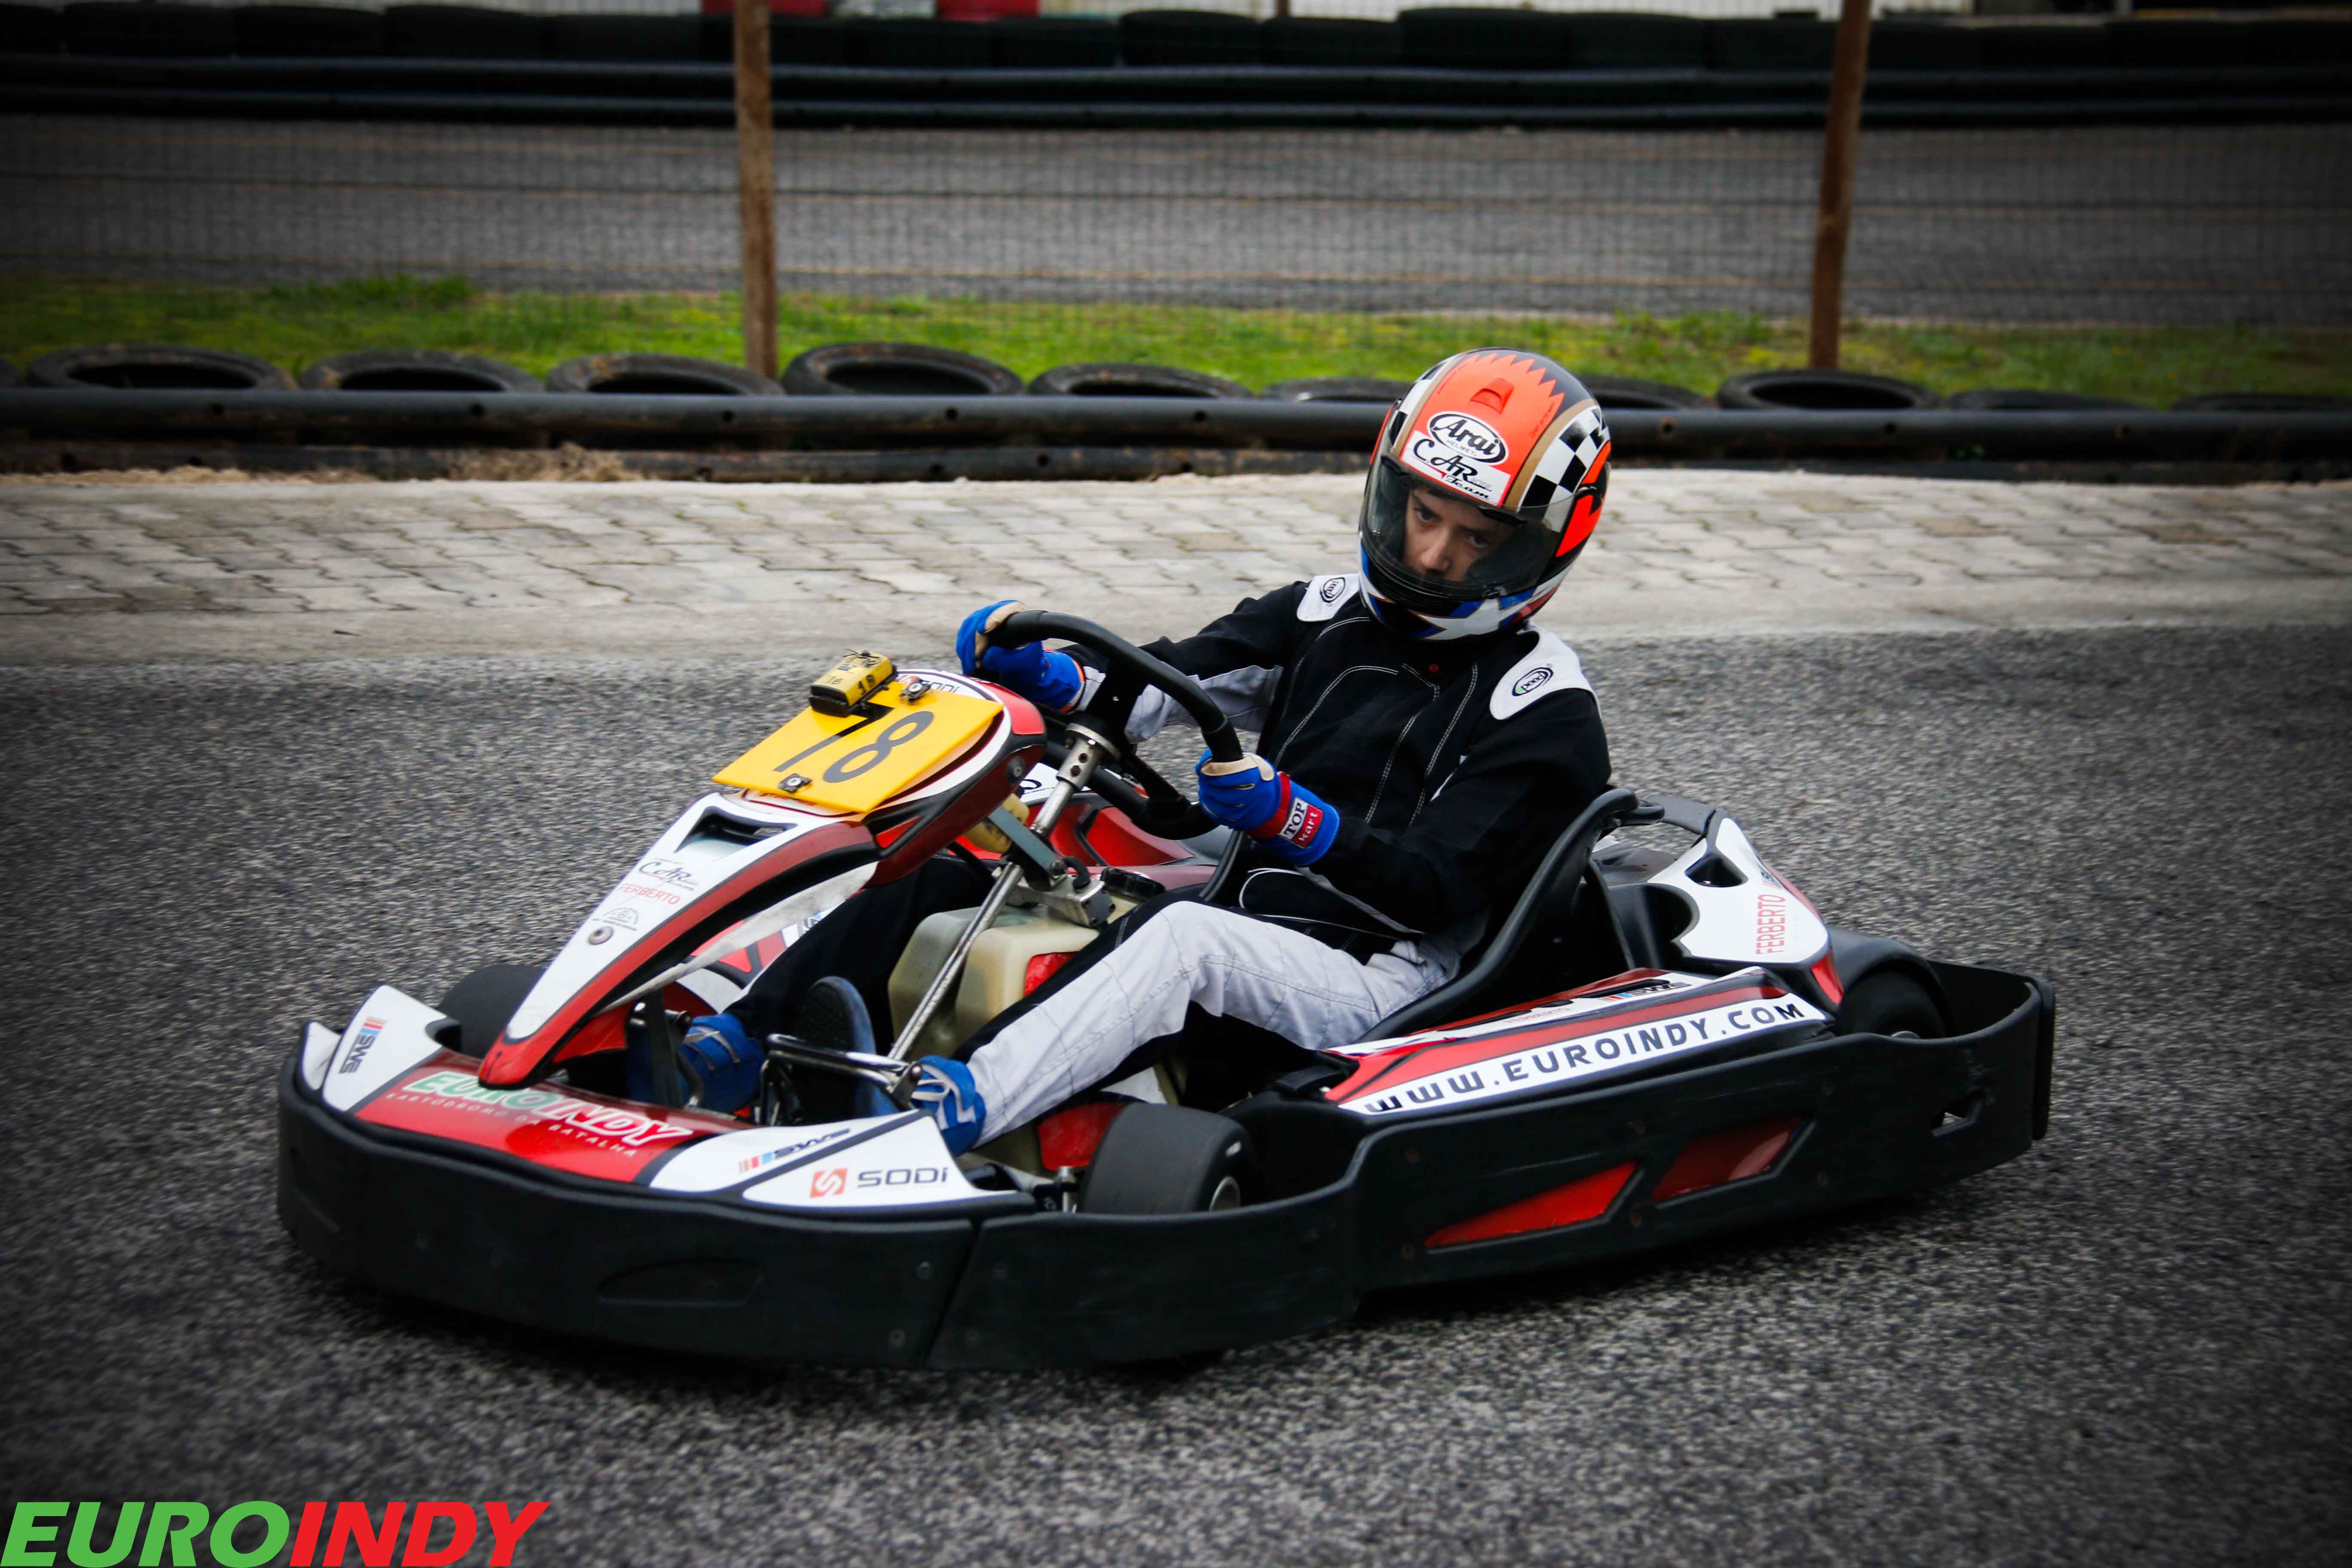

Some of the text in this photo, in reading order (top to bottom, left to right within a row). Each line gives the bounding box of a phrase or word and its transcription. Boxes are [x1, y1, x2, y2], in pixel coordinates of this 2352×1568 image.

[1433, 419, 1500, 455] Arai
[1283, 802, 1305, 835] TOP
[1298, 812, 1318, 841] kart
[620, 884, 681, 904] FERBERTO
[1755, 894, 1785, 955] FERBERTO
[1364, 1003, 1806, 1113] WWW.EUROINDY.COM
[548, 1124, 637, 1157] BATALHA
[856, 1167, 948, 1189] SODI
